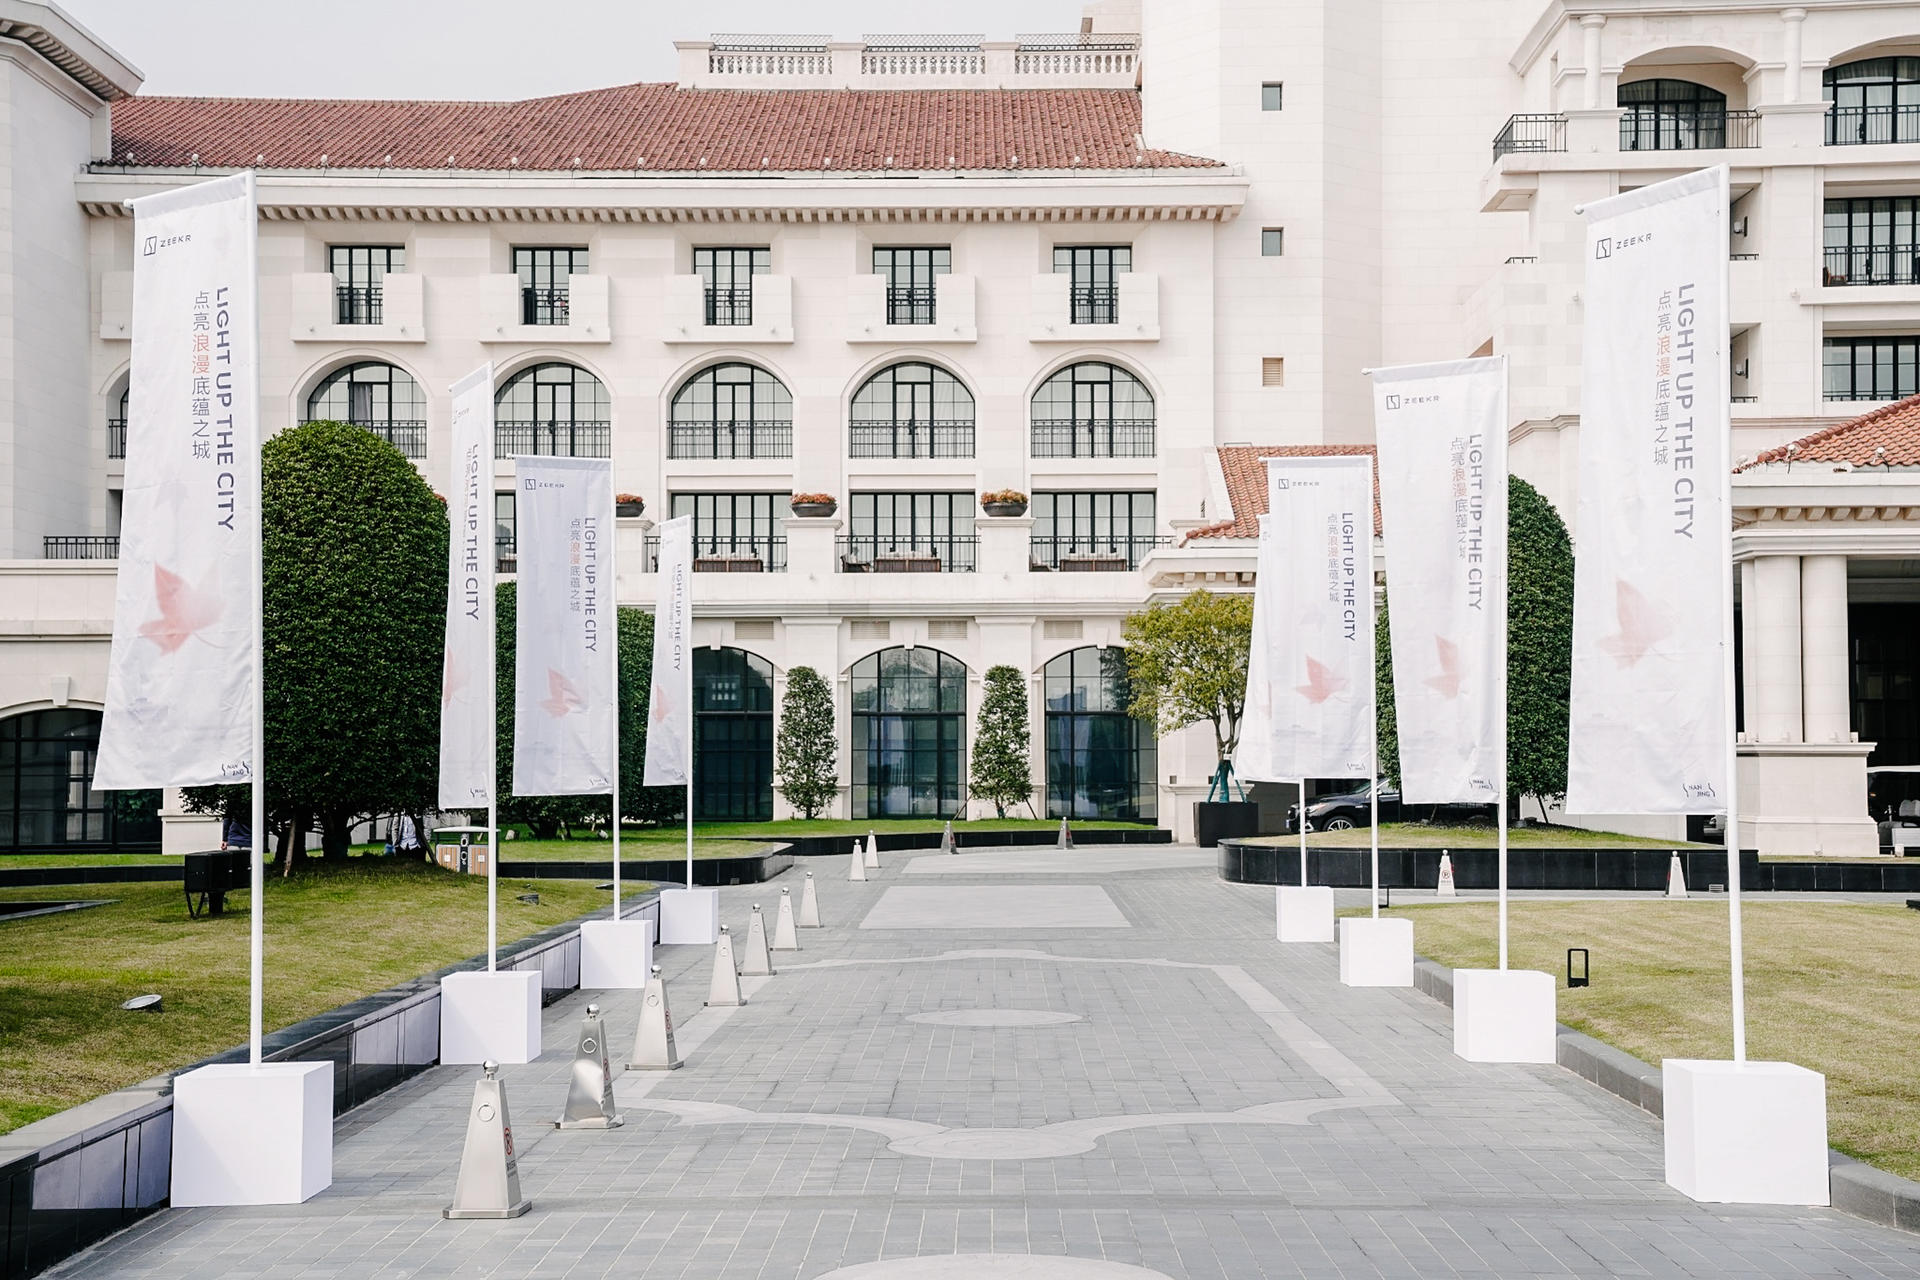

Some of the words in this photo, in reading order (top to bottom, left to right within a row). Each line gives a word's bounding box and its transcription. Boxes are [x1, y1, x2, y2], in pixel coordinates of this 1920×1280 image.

[160, 234, 192, 248] ZEEKR
[1616, 232, 1652, 250] ZEEKR
[216, 286, 231, 365] LIGHT
[1677, 283, 1695, 365] LIGHT
[192, 290, 211, 460] 点亮浪漫底蕴之城
[216, 371, 233, 408] UP
[1654, 289, 1672, 466] 点亮浪漫底蕴之城
[1676, 371, 1694, 410] UP
[1404, 394, 1440, 405] ZEEKR
[216, 413, 234, 466] THE
[1675, 415, 1694, 472] THE
[466, 443, 479, 500] LIGHT
[1469, 433, 1482, 491] LIGHT
[217, 472, 235, 532] CITY
[466, 504, 478, 531] UP
[1469, 495, 1483, 522] UP
[1674, 477, 1695, 539] CITY
[584, 517, 596, 561] LIGHT
[1342, 512, 1354, 554] LIGHT
[1468, 525, 1483, 564] THE
[466, 534, 478, 573] THE
[1343, 557, 1355, 577] UP
[585, 564, 596, 585] UP
[1344, 579, 1356, 607] THE
[1468, 568, 1483, 611] CITY
[466, 577, 479, 621] CITY
[585, 586, 597, 616] THE
[585, 619, 597, 653] CITY
[1344, 610, 1356, 642] CITY
[673, 644, 682, 671] CITY
